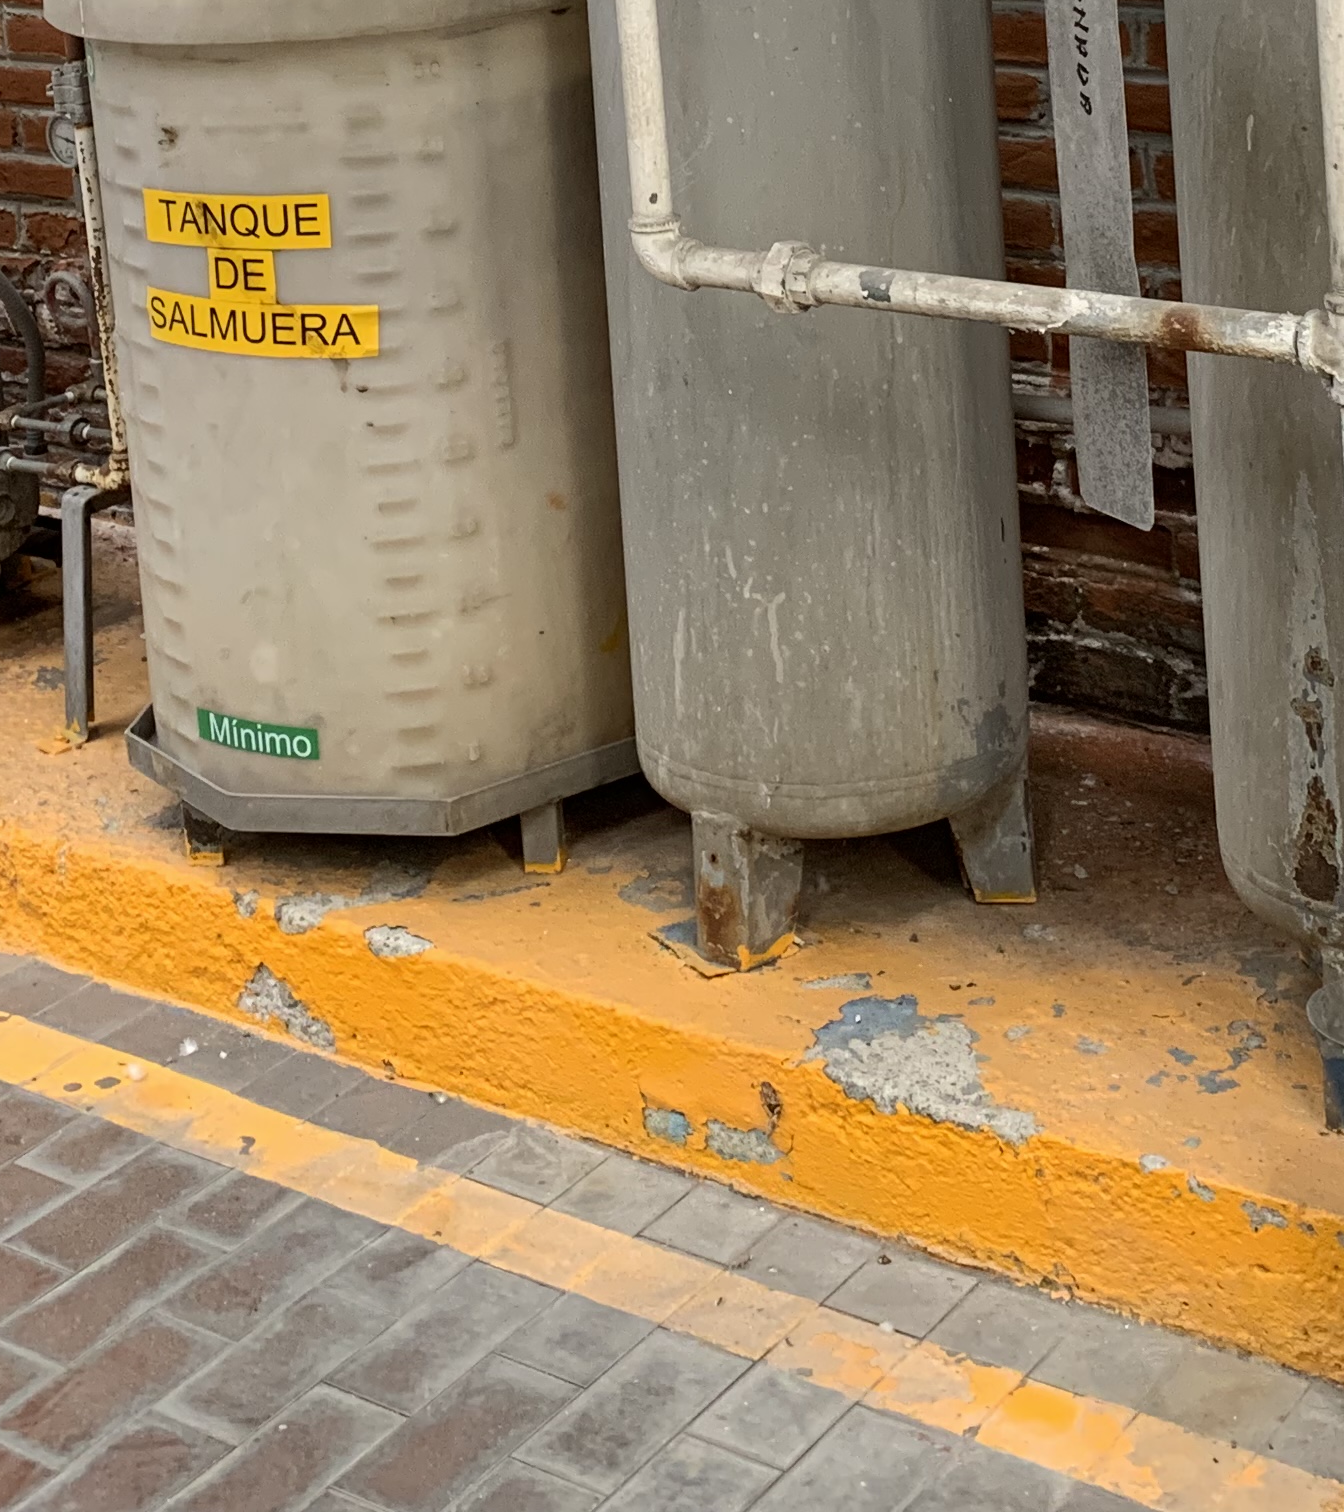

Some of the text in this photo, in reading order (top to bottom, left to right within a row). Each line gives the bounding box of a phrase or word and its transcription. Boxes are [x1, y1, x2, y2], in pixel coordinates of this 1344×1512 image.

[158, 198, 321, 239] TANQUE
[214, 257, 266, 292] DE
[150, 296, 361, 346] SALMUERA
[209, 712, 312, 758] Mínimo
